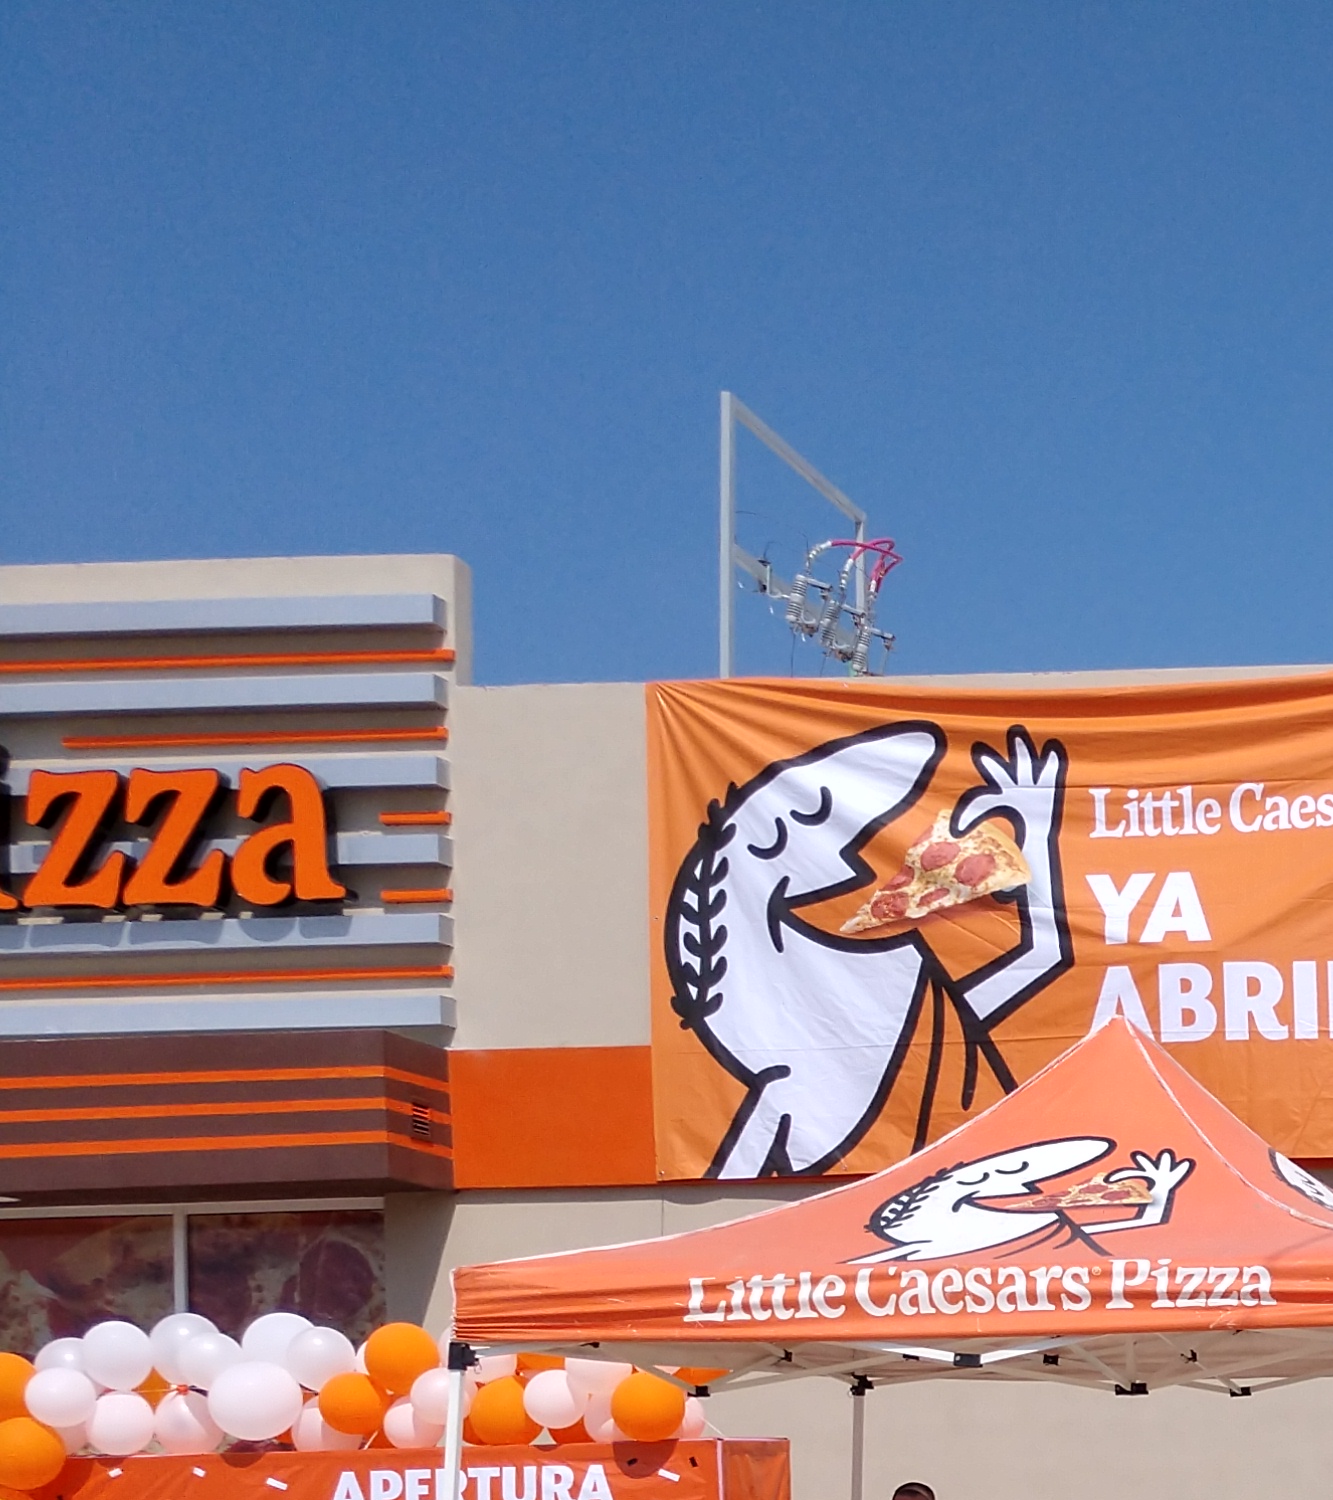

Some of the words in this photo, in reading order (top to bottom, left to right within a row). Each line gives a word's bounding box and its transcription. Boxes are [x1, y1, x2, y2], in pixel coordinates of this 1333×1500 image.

[0, 763, 346, 909] zza
[1089, 786, 1222, 840] Little
[1085, 871, 1212, 945] YA
[683, 1271, 846, 1322] Little
[854, 1266, 1092, 1317] Caesars
[1105, 1258, 1278, 1309] Pizza
